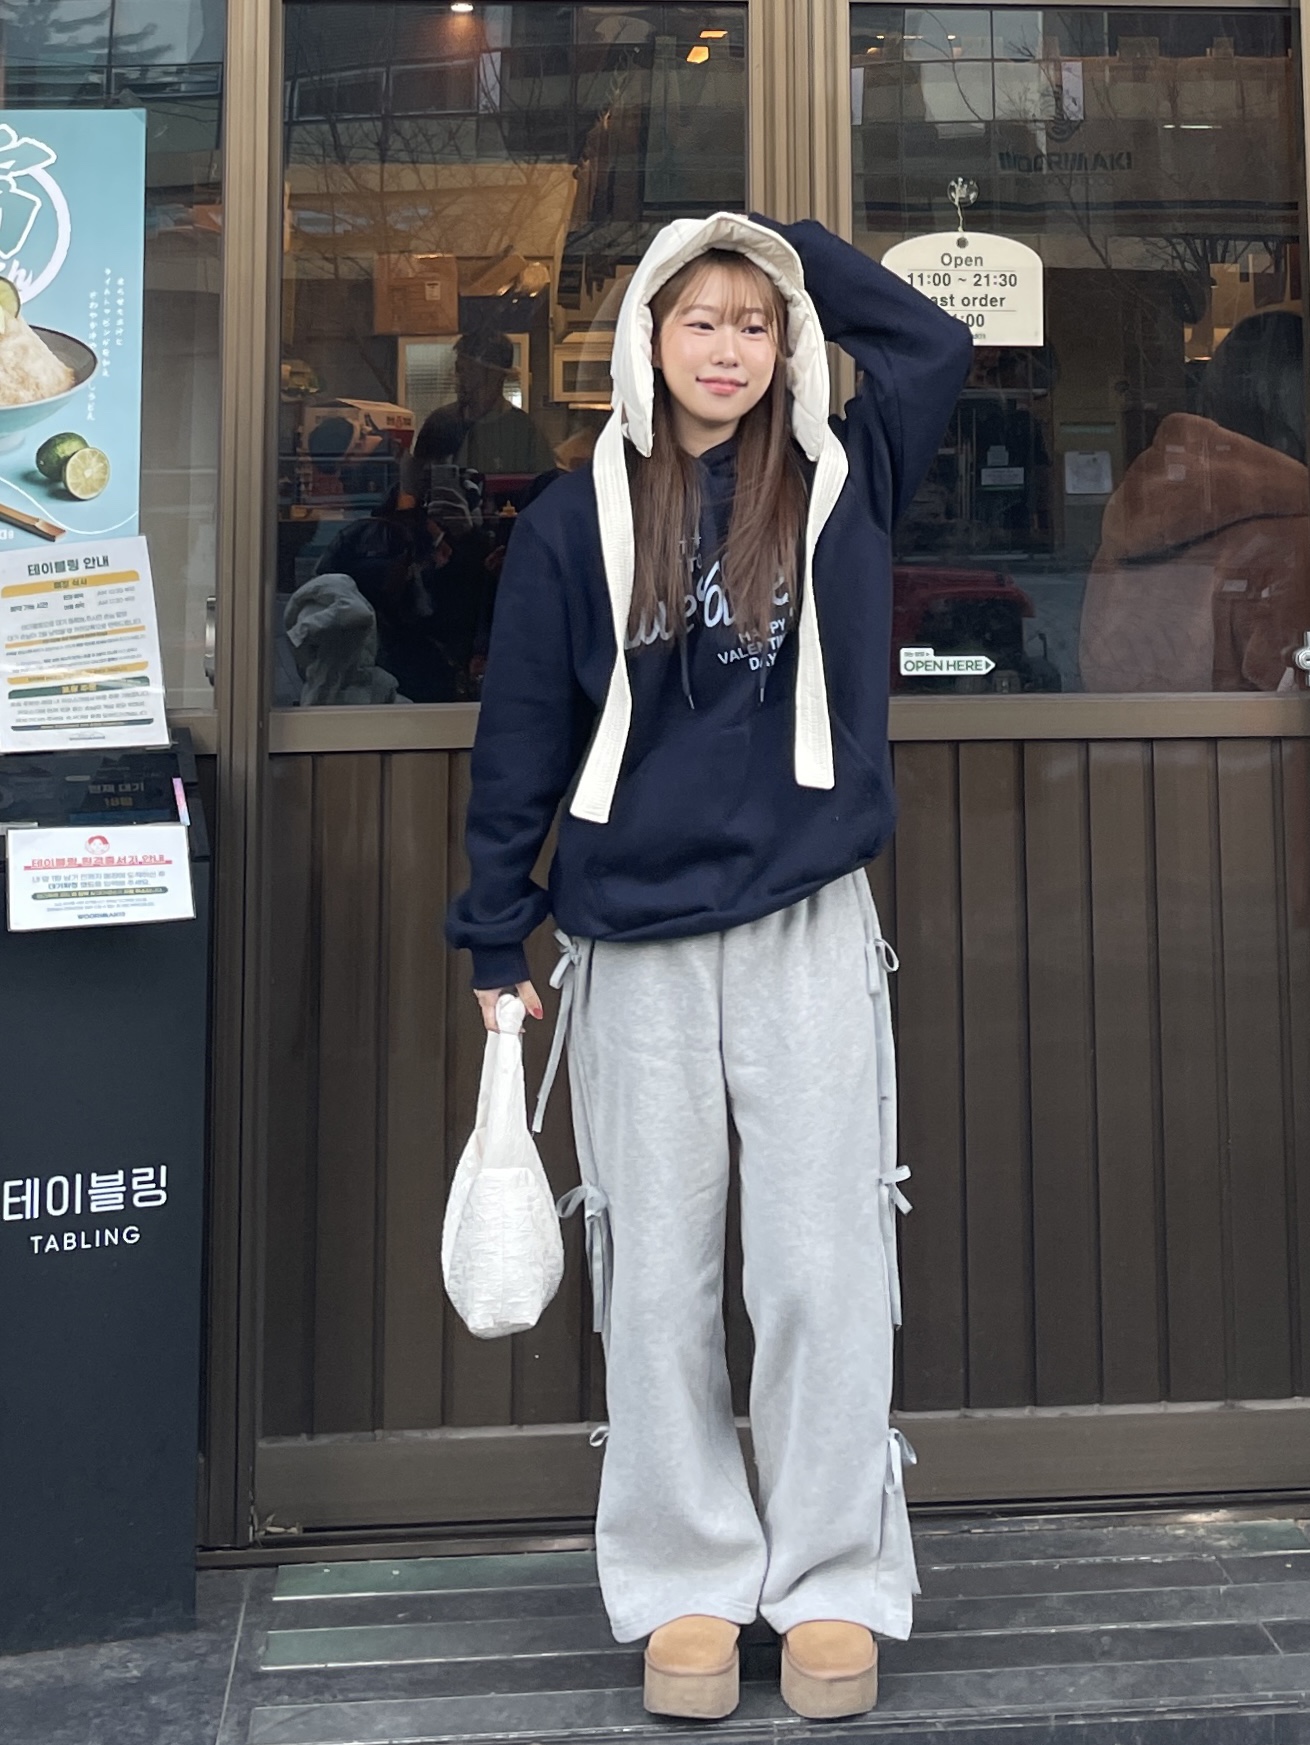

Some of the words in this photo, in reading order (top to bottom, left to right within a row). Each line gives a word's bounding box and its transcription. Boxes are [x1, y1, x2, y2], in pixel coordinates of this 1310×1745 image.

[940, 252, 984, 268] Open
[907, 272, 951, 287] 11:00
[973, 273, 1017, 287] 21:30
[930, 294, 955, 307] ast
[961, 294, 1006, 307] order
[83, 555, 109, 569] 안내
[904, 660, 943, 672] OPEN
[946, 660, 983, 671] HERE
[3, 1164, 168, 1222] 테이블링
[30, 1225, 141, 1254] TABLING
